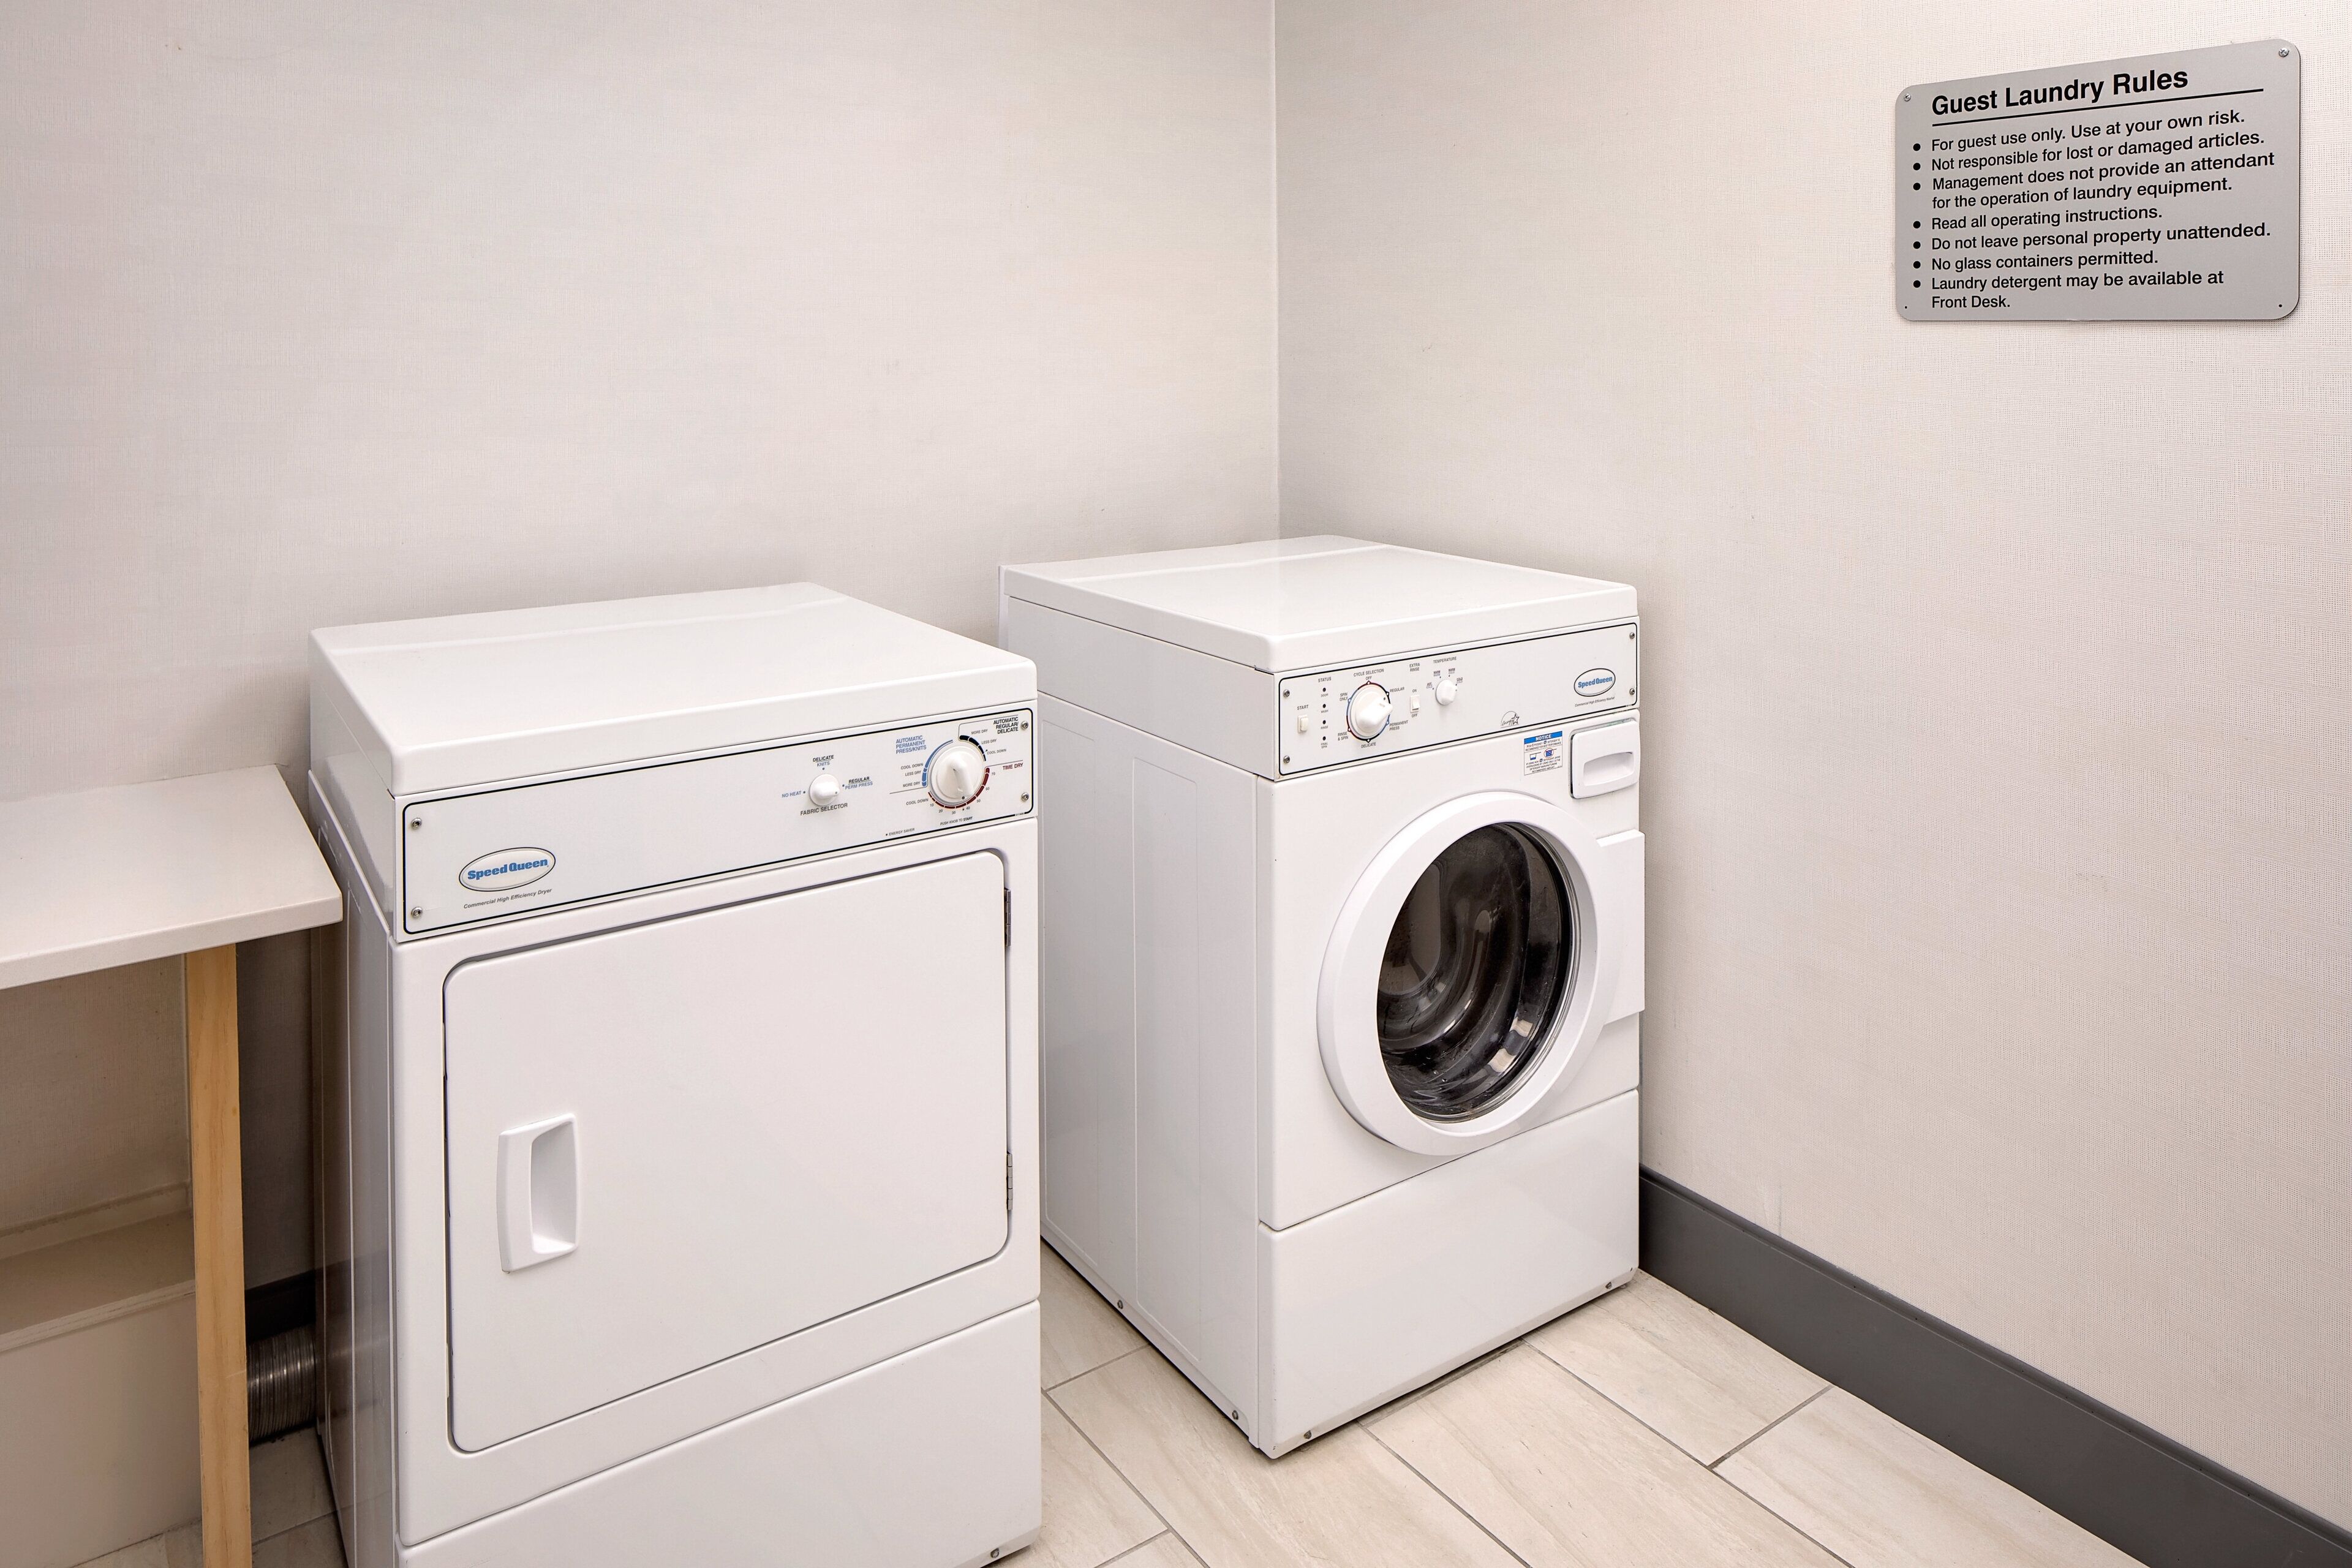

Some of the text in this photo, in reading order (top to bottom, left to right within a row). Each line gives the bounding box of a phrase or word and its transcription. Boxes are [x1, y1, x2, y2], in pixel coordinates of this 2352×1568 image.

[1932, 69, 2188, 116] Guest Laundry Rules
[1932, 109, 2245, 152] For guest use only. Use at your own risk.
[1932, 132, 2264, 171] Not responsible for lost or damaged articles.
[1933, 152, 2275, 191] Management does not provide an attendant
[1932, 177, 2232, 209] for the operation of laundry equipment.
[1932, 206, 2162, 230] Read all operating instructions.
[1932, 222, 2271, 250] Do not leave personal property unattended.
[1932, 250, 2158, 273] No glass containers permitted.
[1932, 271, 2224, 292] Laundry detergent may be available at
[1932, 295, 2010, 308] Front Desk.
[1578, 679, 1596, 688] Speed
[896, 735, 923, 744] AUTOMATIC
[896, 745, 927, 754] PRESS/KNITS
[821, 803, 848, 812] SELECTOR
[467, 859, 548, 880] Speed Queen
[464, 899, 496, 908] Commercial
[497, 895, 510, 904] High
[510, 891, 537, 902] Efficiency
